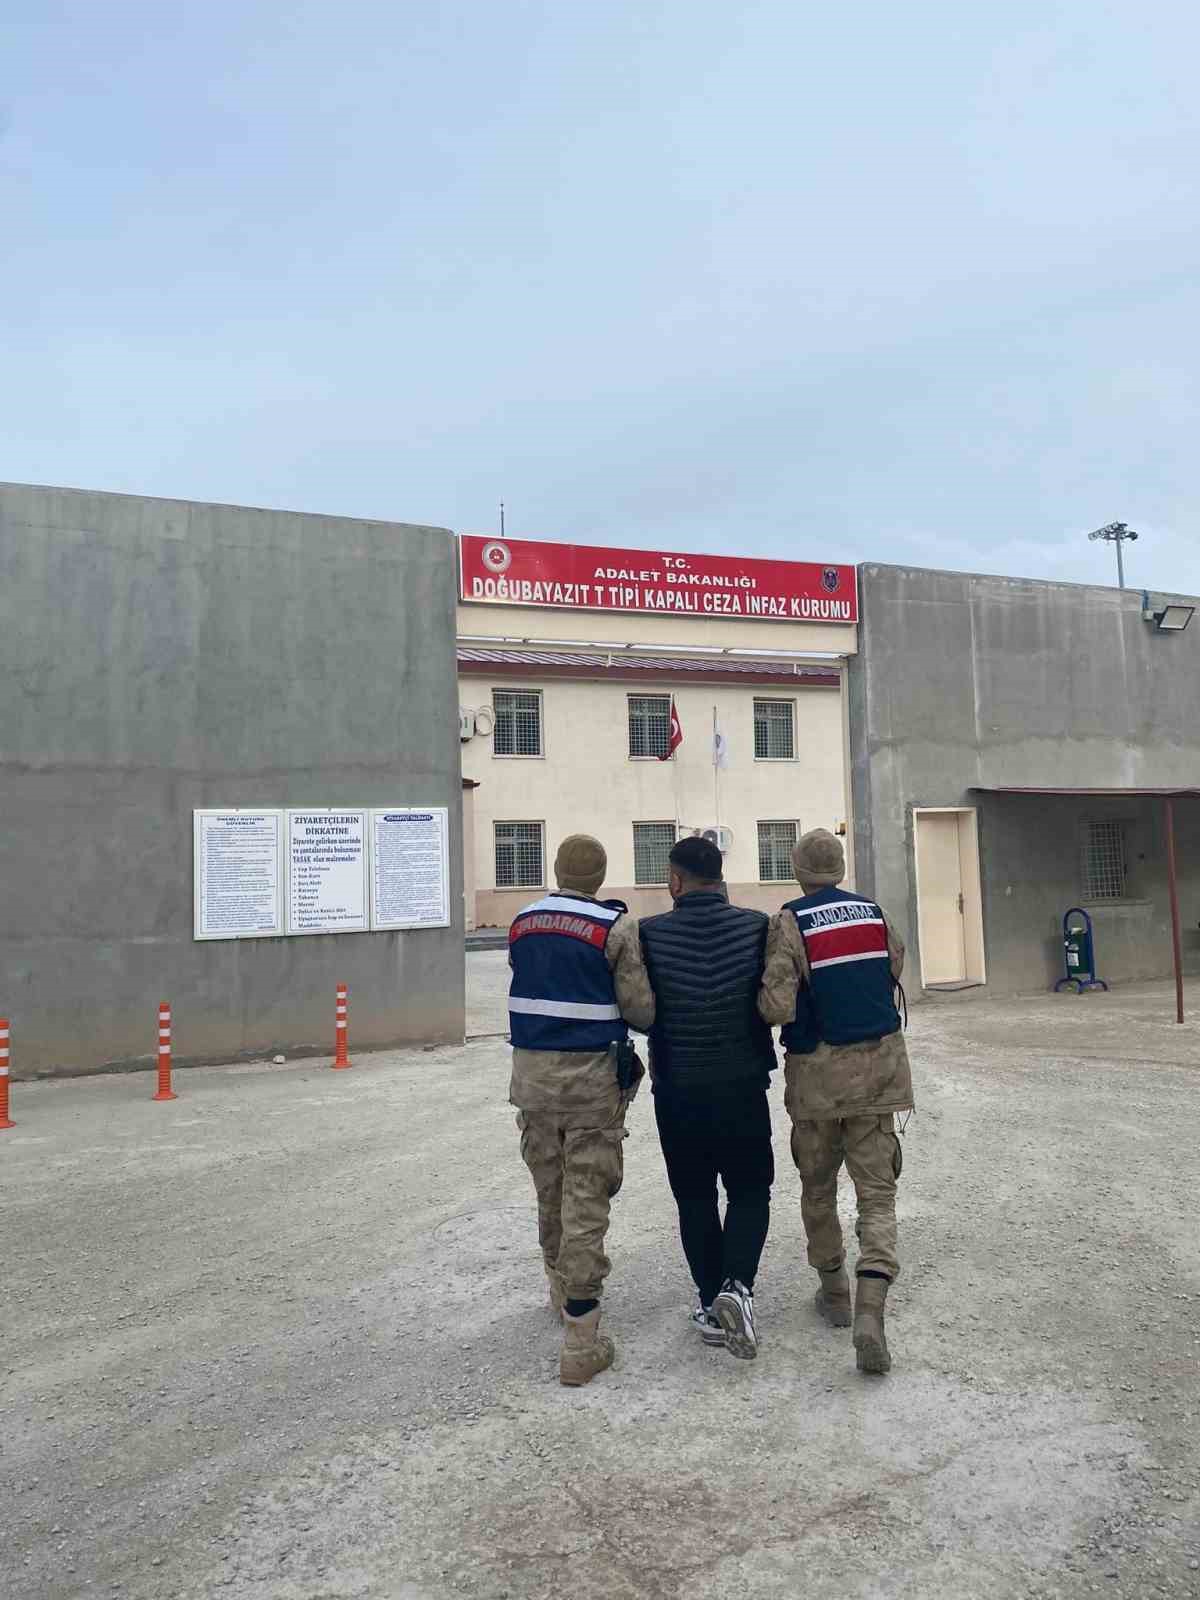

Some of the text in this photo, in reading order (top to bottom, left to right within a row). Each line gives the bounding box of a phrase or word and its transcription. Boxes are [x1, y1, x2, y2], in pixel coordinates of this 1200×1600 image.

[662, 557, 691, 569] T.C.
[594, 567, 756, 589] ADALET BAKANLIĞI
[472, 574, 851, 619] DOĞUBAYAZIT T TİPİ KAPALI CEZA İNFAZ KURUMU
[810, 905, 876, 927] JANDARMA
